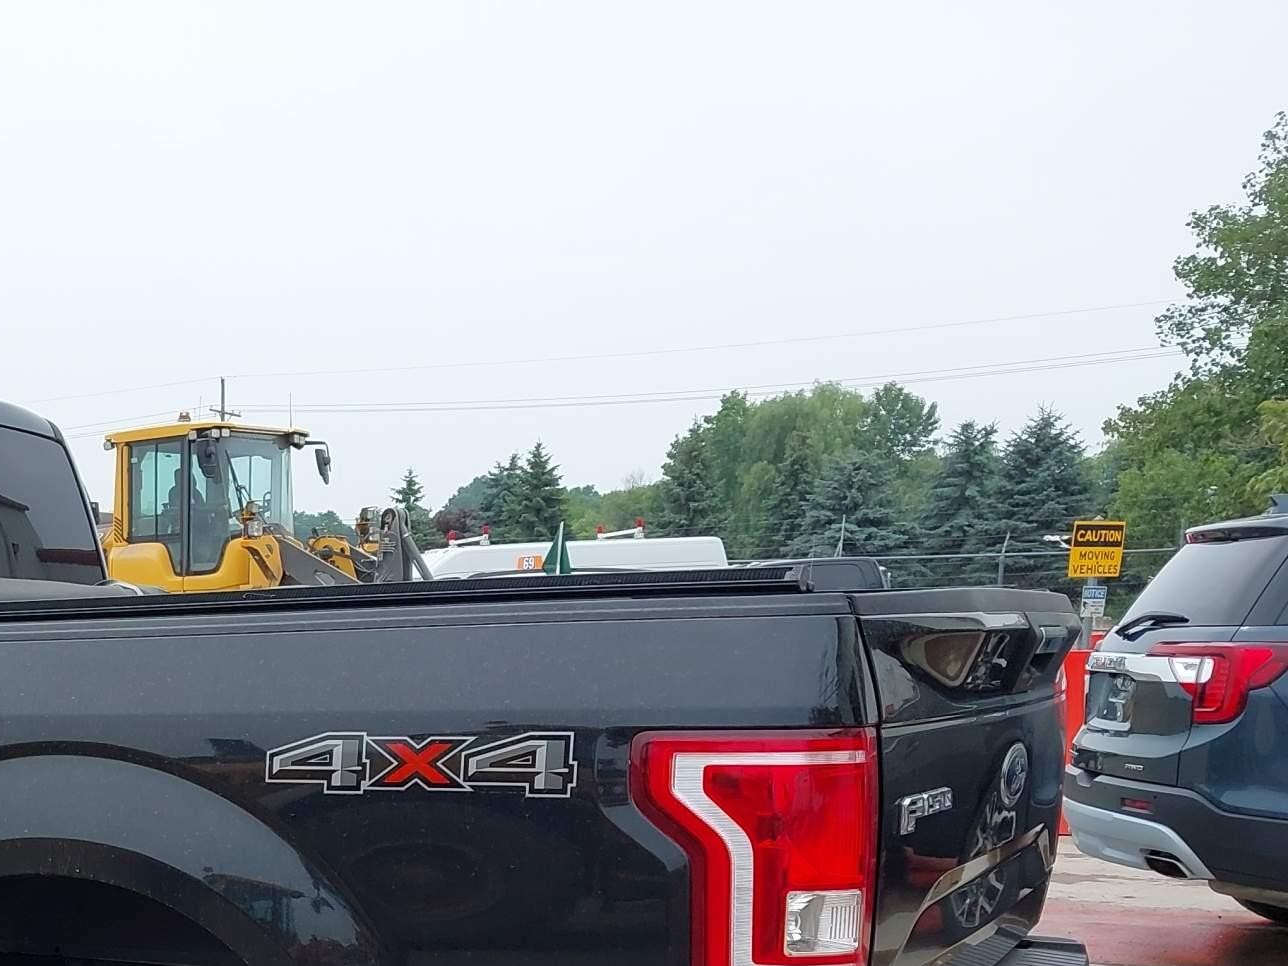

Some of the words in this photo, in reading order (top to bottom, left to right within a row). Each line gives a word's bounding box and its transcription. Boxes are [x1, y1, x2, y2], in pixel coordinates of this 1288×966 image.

[1077, 530, 1122, 542] CAUTION
[1079, 550, 1115, 560] MOVING
[523, 557, 535, 570] 69
[1072, 564, 1118, 574] VEHICLES
